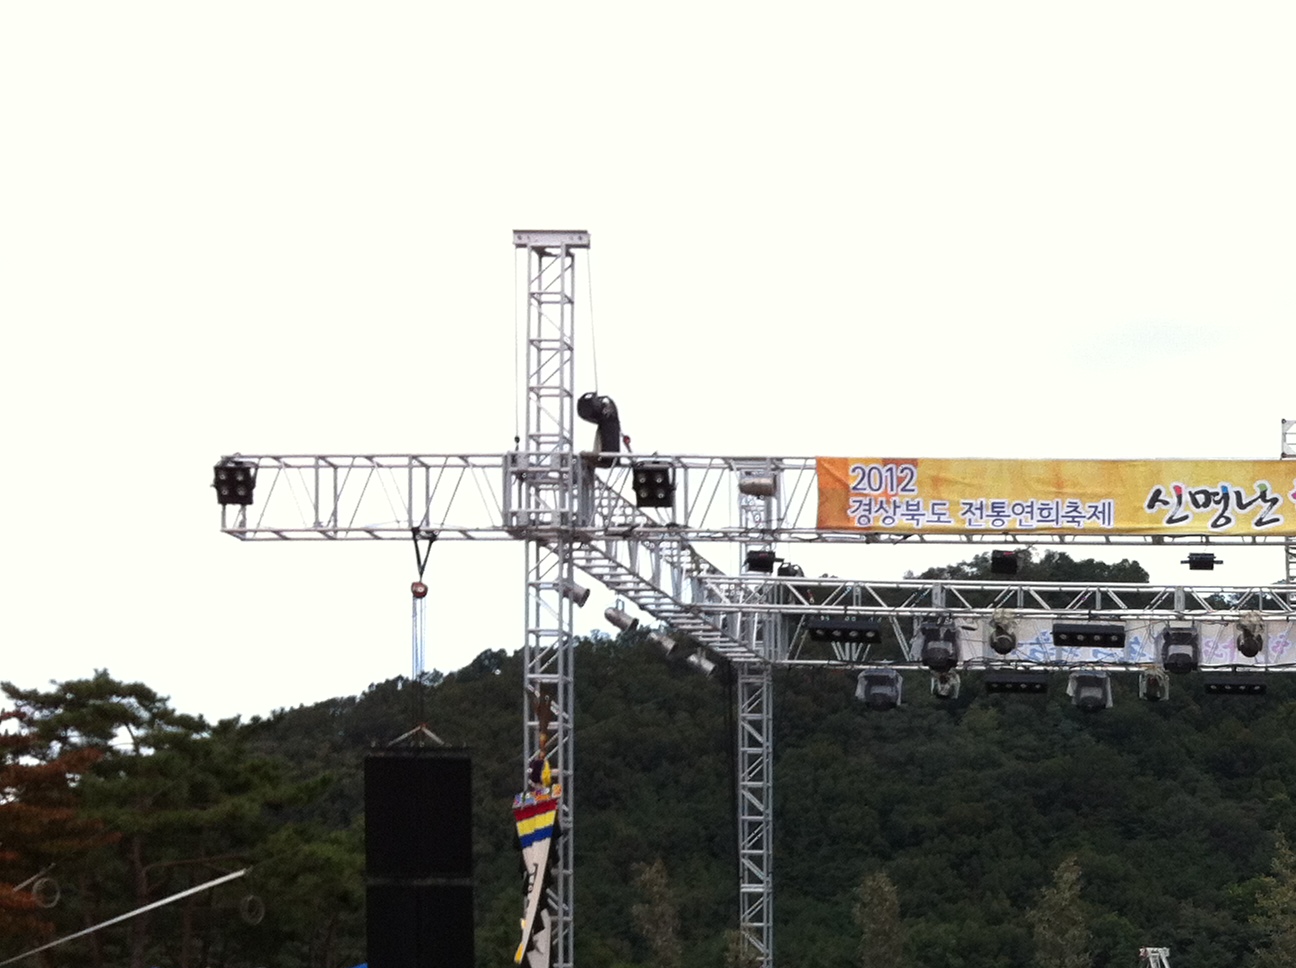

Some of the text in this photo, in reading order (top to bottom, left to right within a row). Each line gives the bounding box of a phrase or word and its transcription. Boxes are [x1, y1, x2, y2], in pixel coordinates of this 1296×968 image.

[851, 465, 917, 493] 2012
[849, 499, 1113, 527] 경상북도 전통연희축제
[1146, 483, 1281, 527] 신명난
